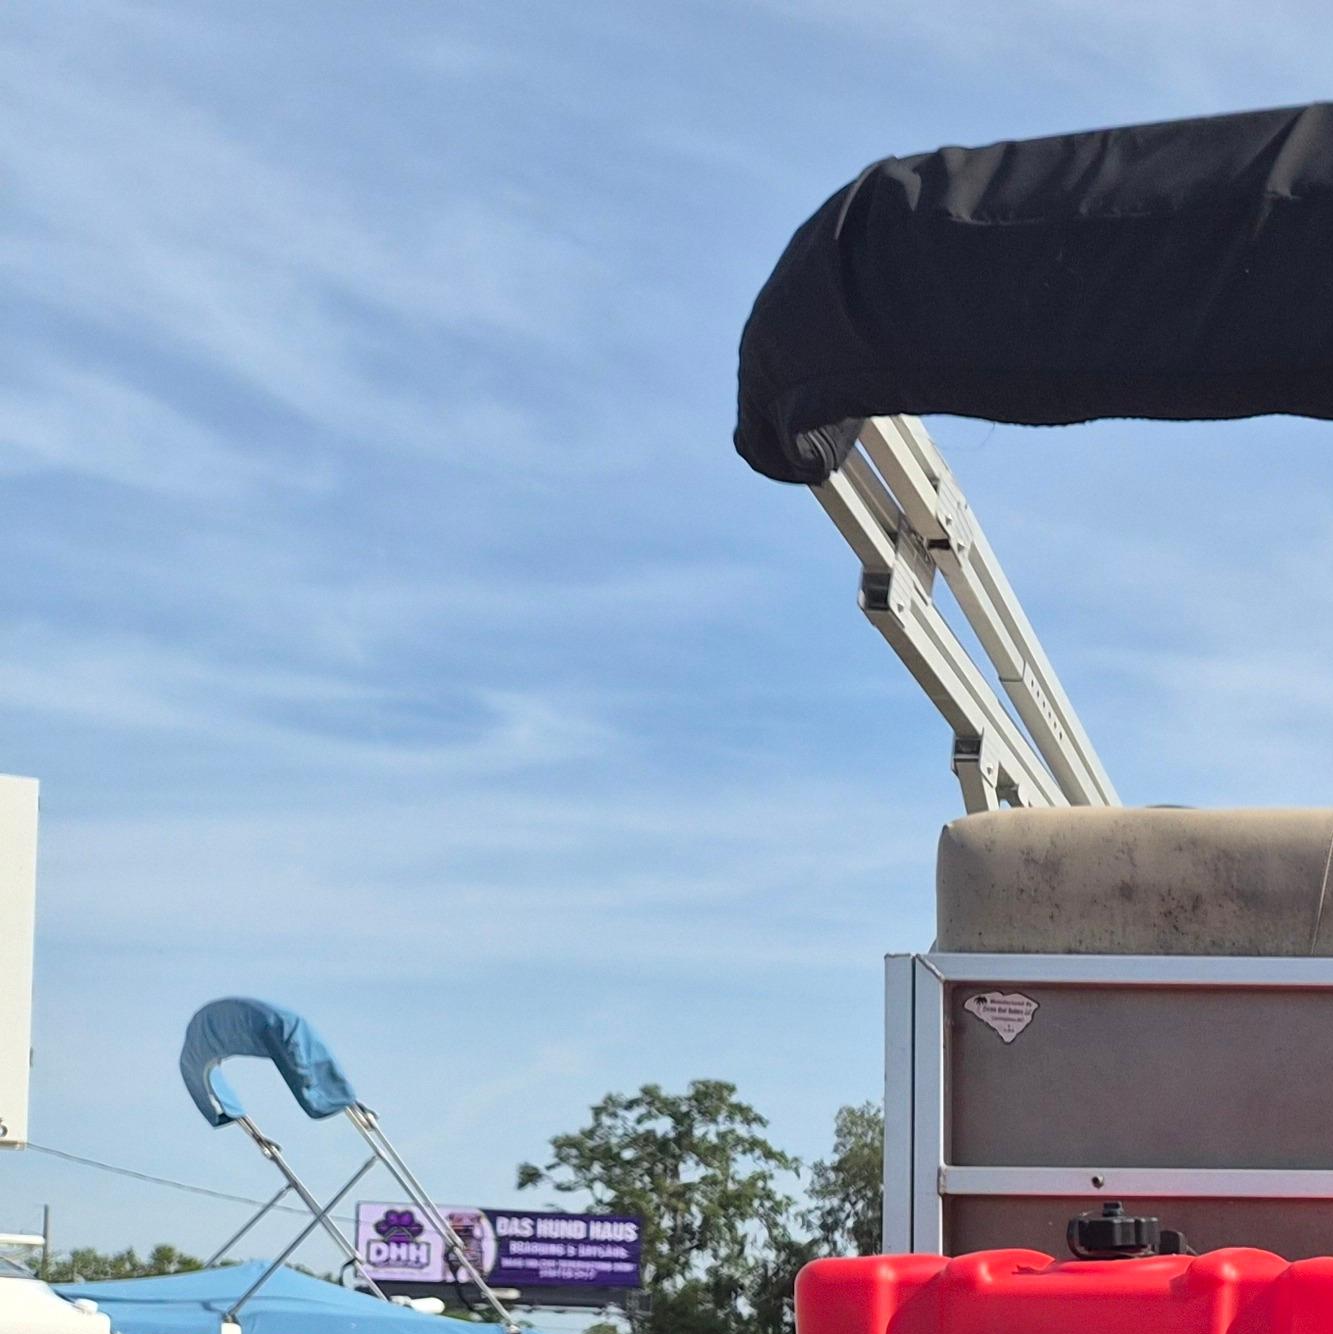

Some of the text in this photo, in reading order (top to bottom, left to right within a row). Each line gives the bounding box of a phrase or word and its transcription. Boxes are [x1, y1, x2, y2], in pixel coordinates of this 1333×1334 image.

[496, 1216, 639, 1242] DAS HUND HAUS
